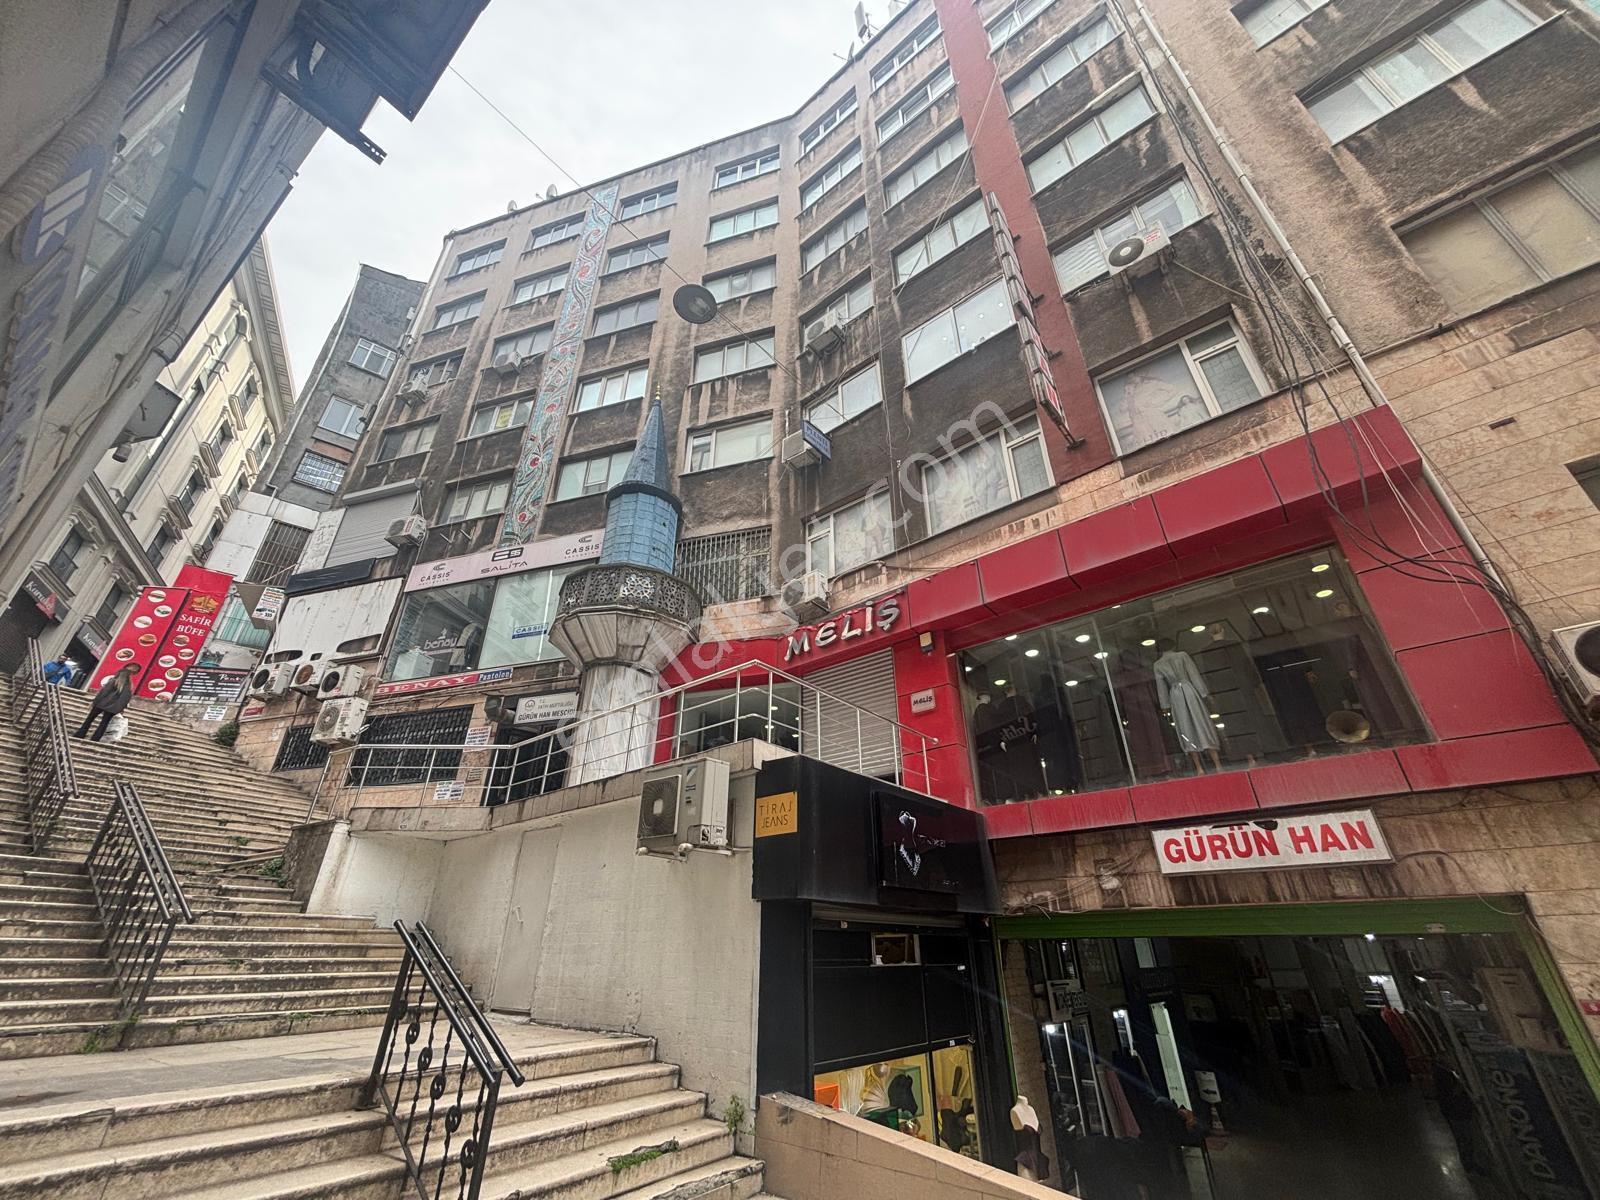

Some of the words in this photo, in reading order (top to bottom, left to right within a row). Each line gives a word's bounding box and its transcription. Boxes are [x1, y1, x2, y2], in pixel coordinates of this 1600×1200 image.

[565, 543, 600, 555] CASSIS
[480, 560, 528, 574] SALİTA
[420, 571, 451, 583] CASSIS
[179, 613, 212, 627] SAFİR
[175, 624, 206, 637] BÜFE
[784, 598, 901, 661] MELİŞ
[376, 675, 472, 694] BENAY
[538, 710, 551, 719] HAN
[761, 814, 789, 829] JEANS
[1163, 825, 1280, 864] GÜRÜN
[1287, 820, 1375, 855] HAN
